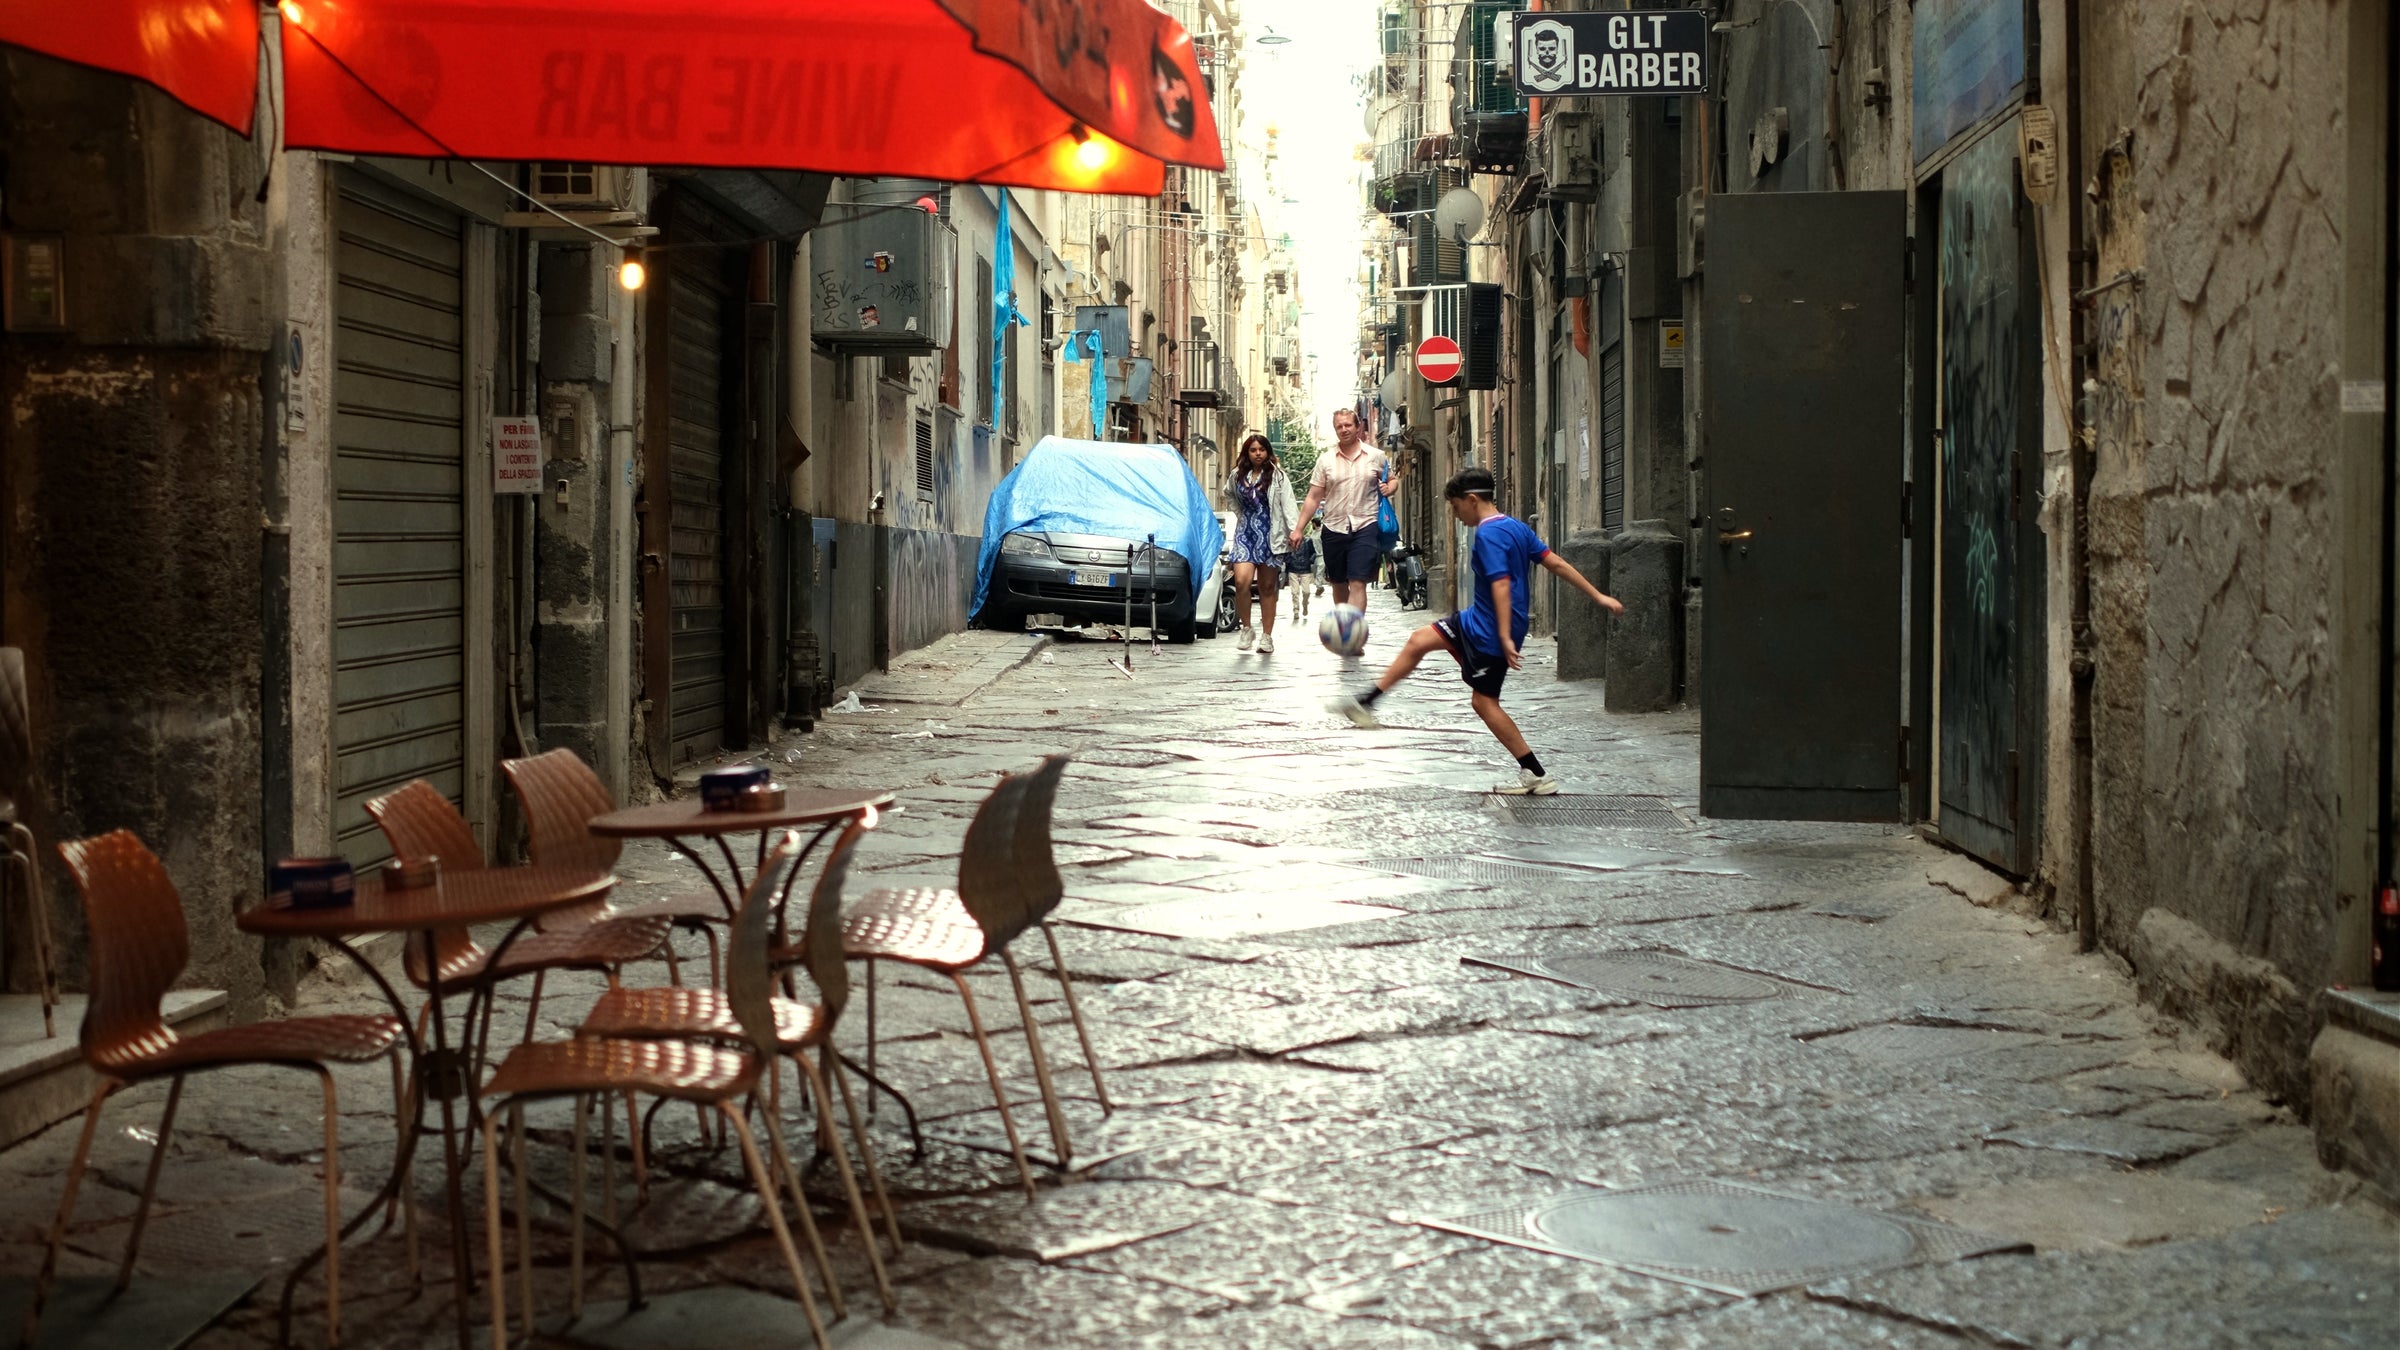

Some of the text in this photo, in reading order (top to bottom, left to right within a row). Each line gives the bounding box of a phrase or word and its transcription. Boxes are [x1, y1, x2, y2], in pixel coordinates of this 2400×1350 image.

[1608, 15, 1668, 50] GLT
[1578, 52, 1700, 88] BARBER
[503, 425, 518, 435] PER
[499, 440, 513, 449] NON
[499, 470, 516, 479] DELLA
